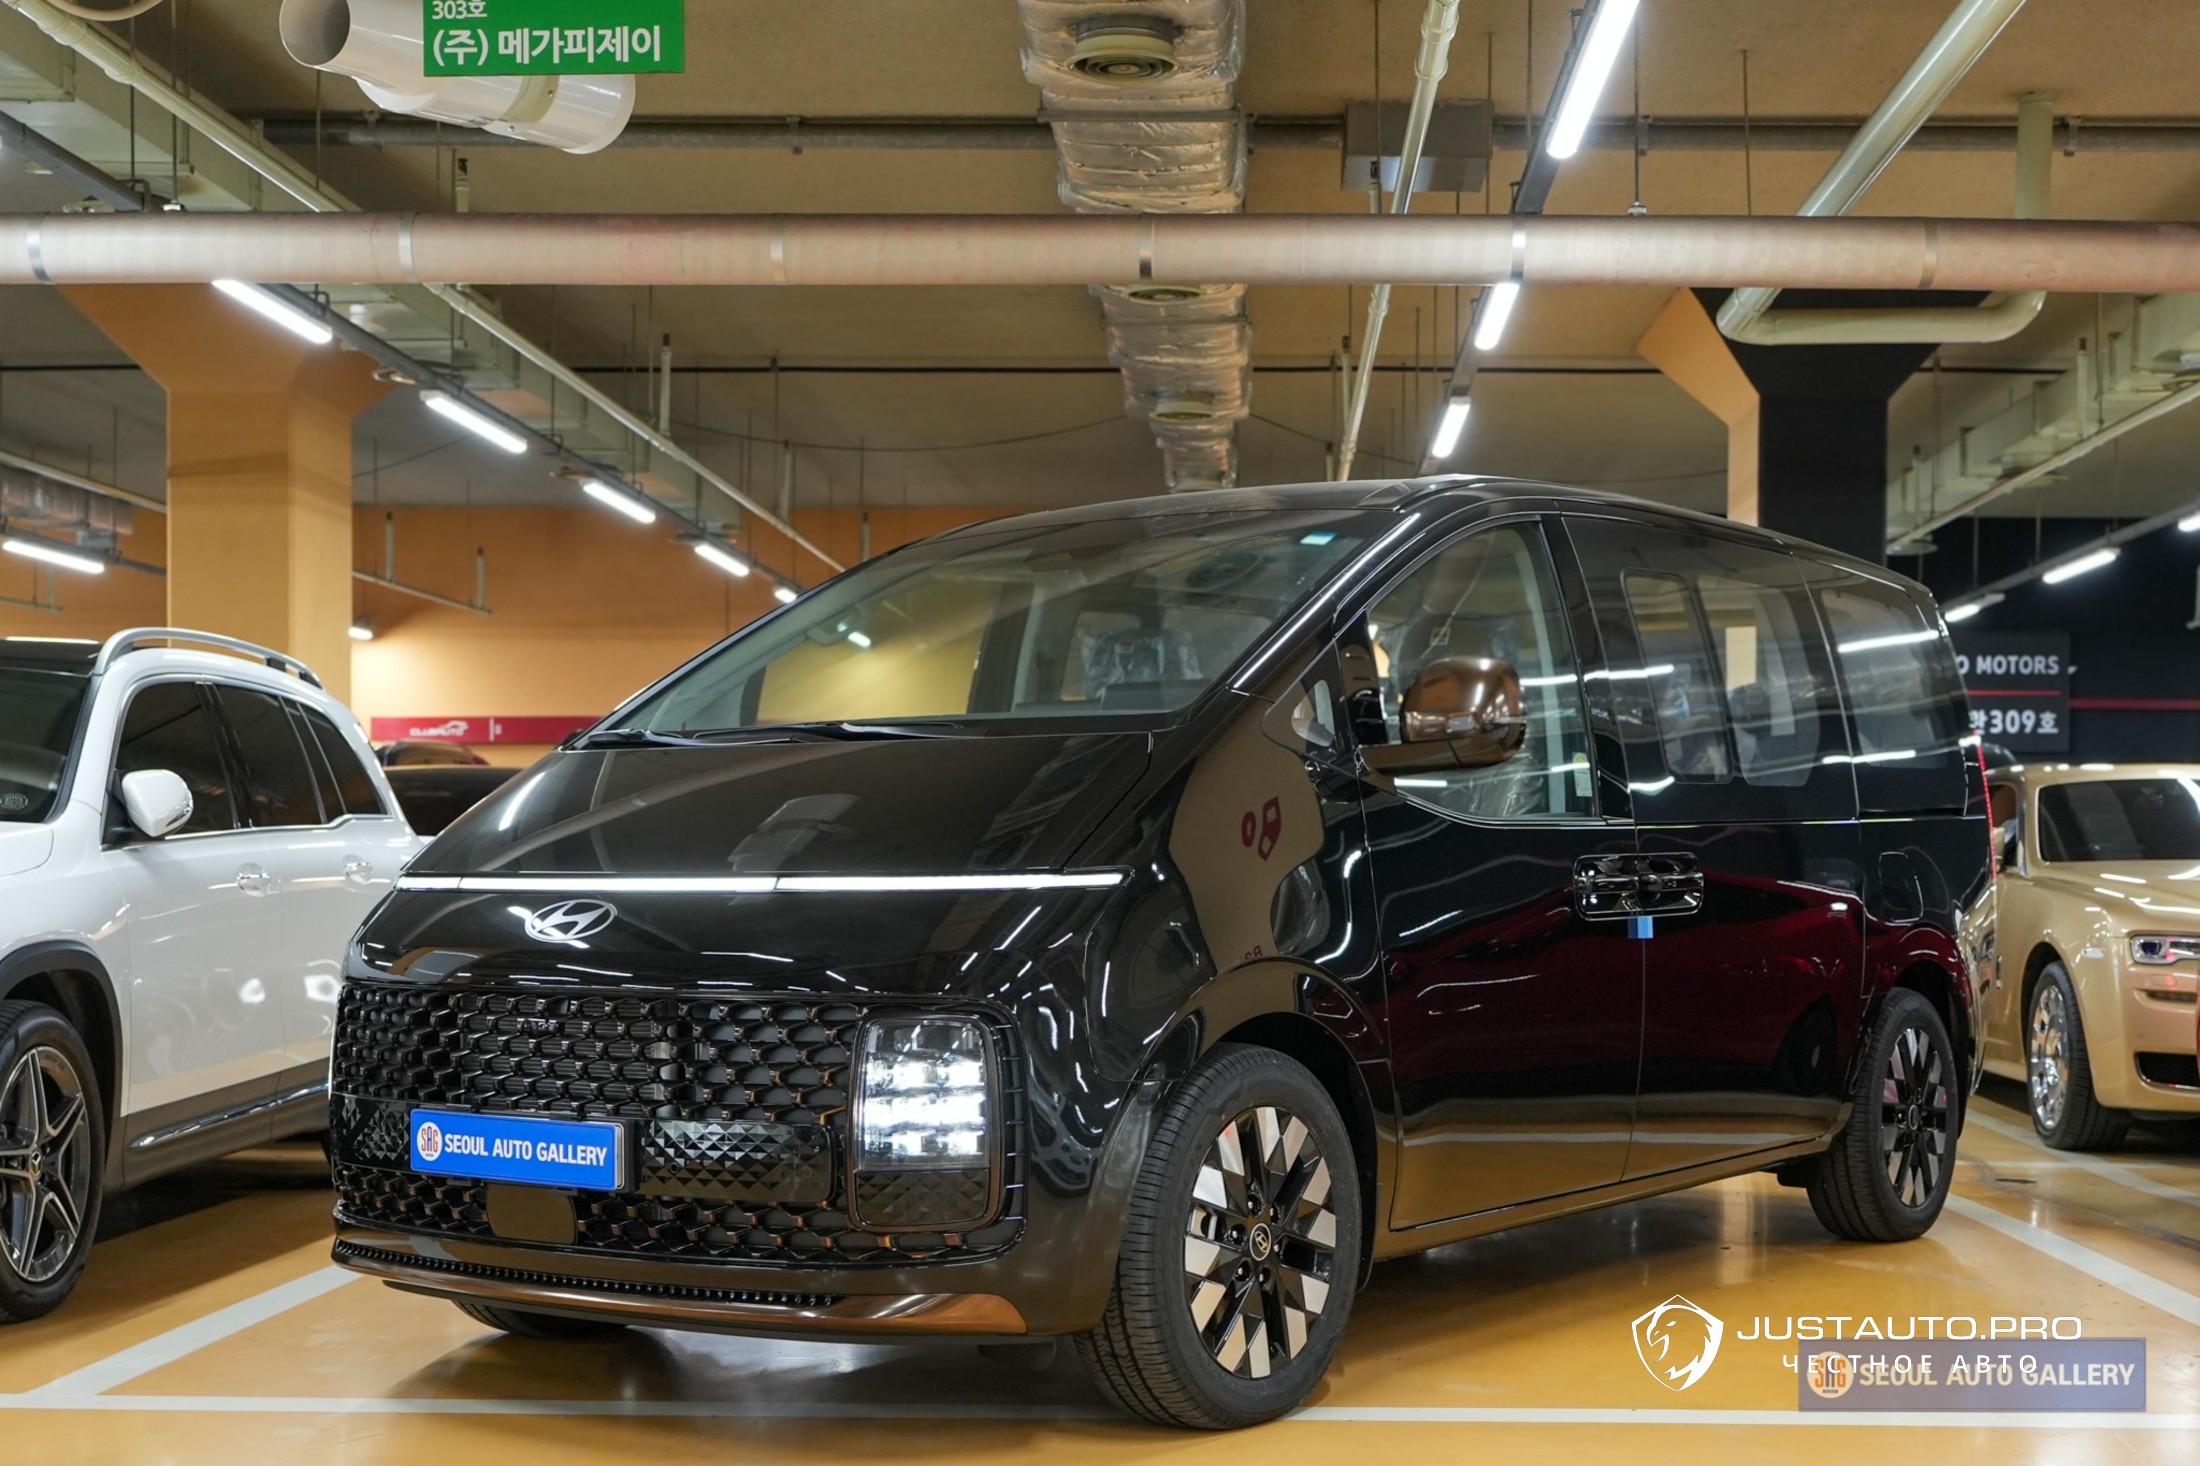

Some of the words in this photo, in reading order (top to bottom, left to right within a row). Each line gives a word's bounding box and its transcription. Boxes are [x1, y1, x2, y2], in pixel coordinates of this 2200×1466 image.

[432, 0, 487, 19] 303호
[433, 29, 489, 66] (주)
[498, 25, 661, 64] 메가피제이
[1976, 655, 2060, 675] MOTORS
[421, 1126, 438, 1153] SAG
[444, 1133, 489, 1156] SEOUL
[492, 1139, 533, 1160] AUTO
[536, 1142, 607, 1167] GALLERY
